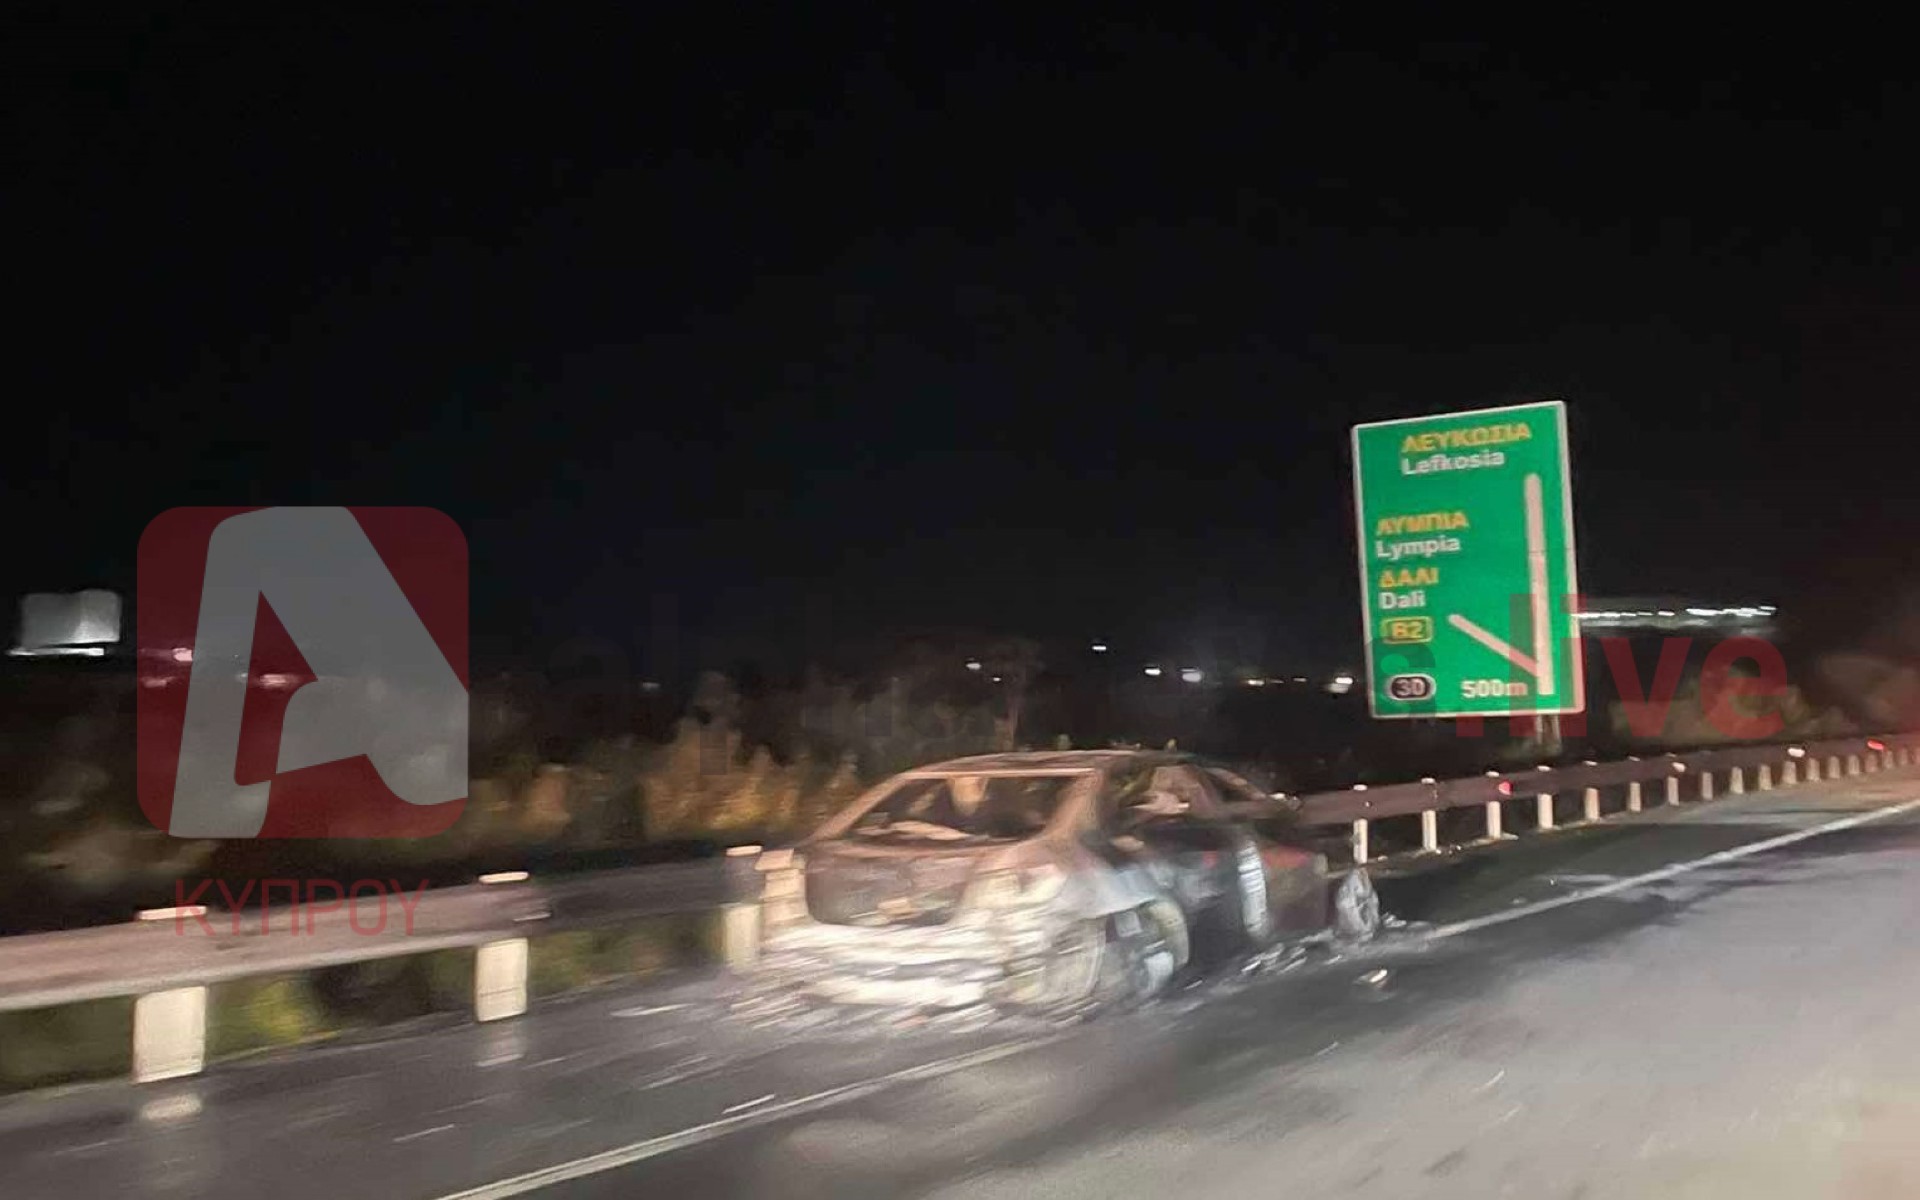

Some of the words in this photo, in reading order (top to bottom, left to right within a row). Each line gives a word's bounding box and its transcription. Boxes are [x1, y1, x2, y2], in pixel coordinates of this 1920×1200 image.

[1401, 450, 1505, 475] Lefkosia
[1376, 535, 1461, 561] Lympia
[1380, 589, 1427, 610] Dali
[1391, 620, 1423, 639] B2
[1395, 677, 1427, 697] 30
[1461, 679, 1528, 699] 500m
